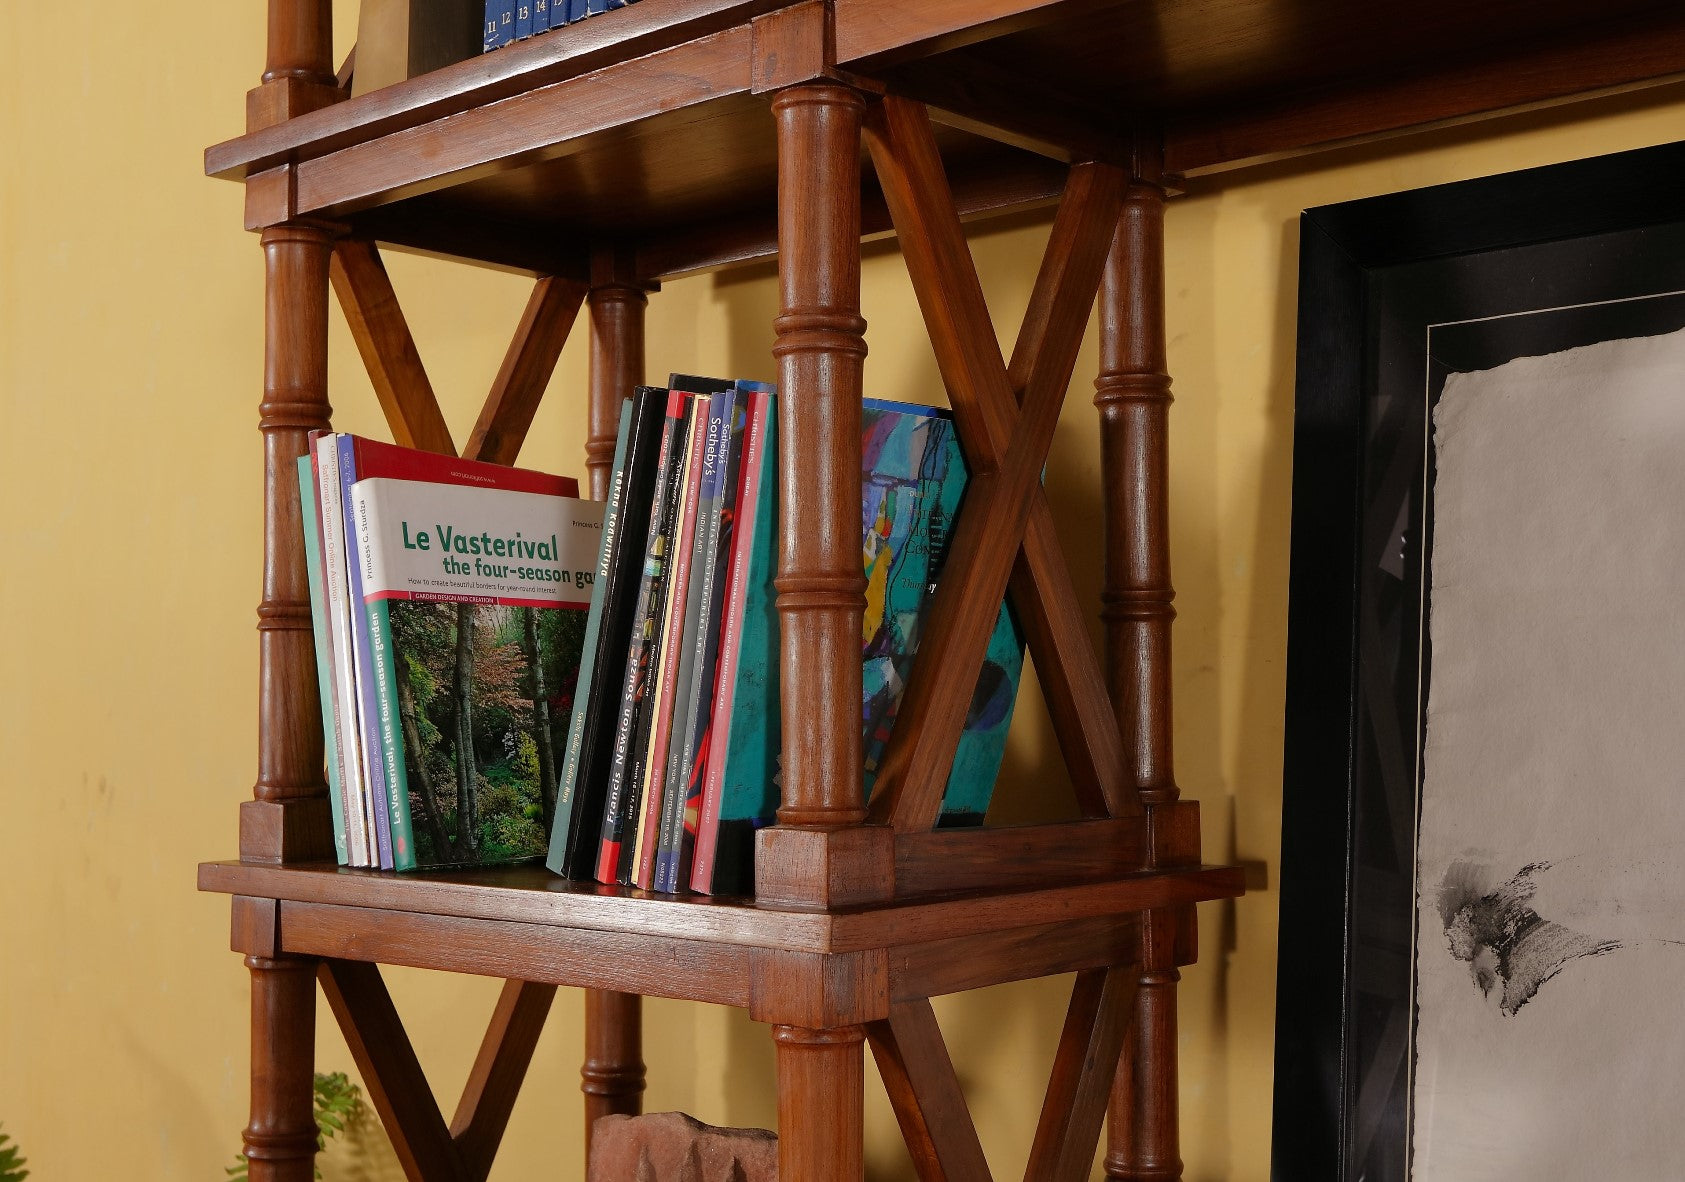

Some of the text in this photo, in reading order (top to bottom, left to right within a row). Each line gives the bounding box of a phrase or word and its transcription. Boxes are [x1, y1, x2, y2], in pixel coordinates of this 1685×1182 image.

[502, 12, 510, 24] 12
[519, 6, 528, 19] 13
[537, 0, 545, 12] 14
[488, 21, 496, 33] 11
[704, 417, 721, 475] Sotheby's
[719, 424, 729, 464] Sotheby's
[360, 499, 368, 531] Sturdza
[698, 511, 706, 538] INDIAN
[401, 521, 558, 561] Le Vasterival
[365, 544, 373, 579] Princess
[443, 555, 471, 576] the
[475, 559, 571, 583] four-season
[498, 582, 506, 590] for
[506, 585, 536, 593] year-round
[371, 612, 401, 824] Le Vasterival, the four-season garden
[607, 771, 621, 823] Francis
[616, 707, 631, 765] Newton
[626, 658, 638, 701] Souza
